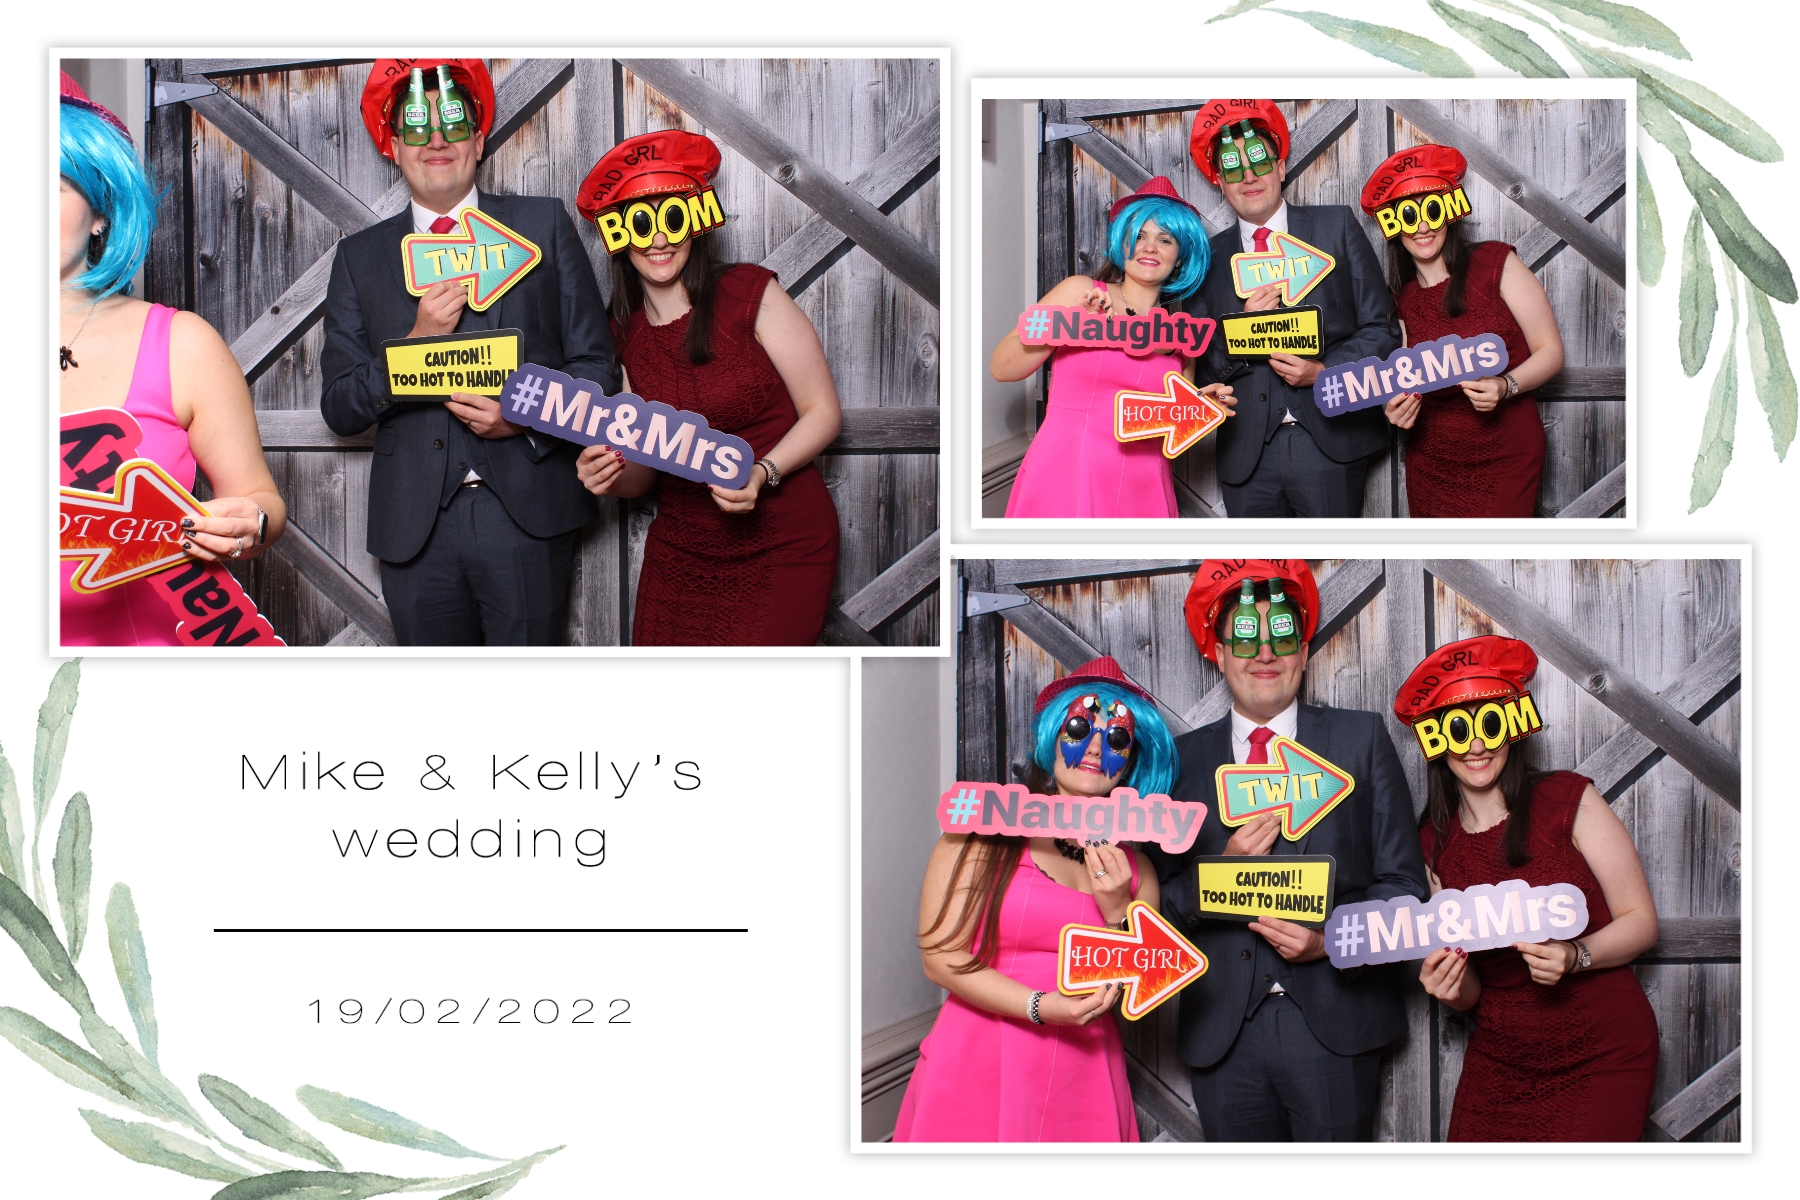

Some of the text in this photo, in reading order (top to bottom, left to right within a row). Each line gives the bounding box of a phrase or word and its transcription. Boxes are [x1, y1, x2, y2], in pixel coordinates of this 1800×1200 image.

[594, 169, 623, 201] BAD
[595, 186, 726, 254] BOOM
[1375, 184, 1472, 240] BOOM
[424, 242, 510, 276] TWIT
[1248, 255, 1311, 282] TWIT
[1024, 309, 1211, 350] #Naughty
[1250, 317, 1299, 334] CAUTION!!
[425, 345, 492, 367] CAUTION!!
[1228, 335, 1317, 349] TOO HOT TO HANDLE
[392, 374, 418, 387] TOO
[420, 372, 444, 387] HOT
[447, 371, 464, 387] TO
[1321, 341, 1500, 409] #Mr&Mrs
[510, 373, 745, 480] #Mr&Mrs
[1124, 405, 1210, 424] HOT GIRL
[1273, 621, 1290, 630] BEER
[1411, 675, 1440, 707] BAD
[1413, 691, 1543, 761] BOOM
[1238, 771, 1323, 806] TWIT
[946, 788, 1199, 845] #Naughty
[1235, 869, 1303, 890] CAUTION!!
[1202, 890, 1325, 915] TOO HOT TO HANDLE
[1334, 890, 1577, 957] #Mr&Mrs
[1072, 945, 1188, 973] HOT GIRL
